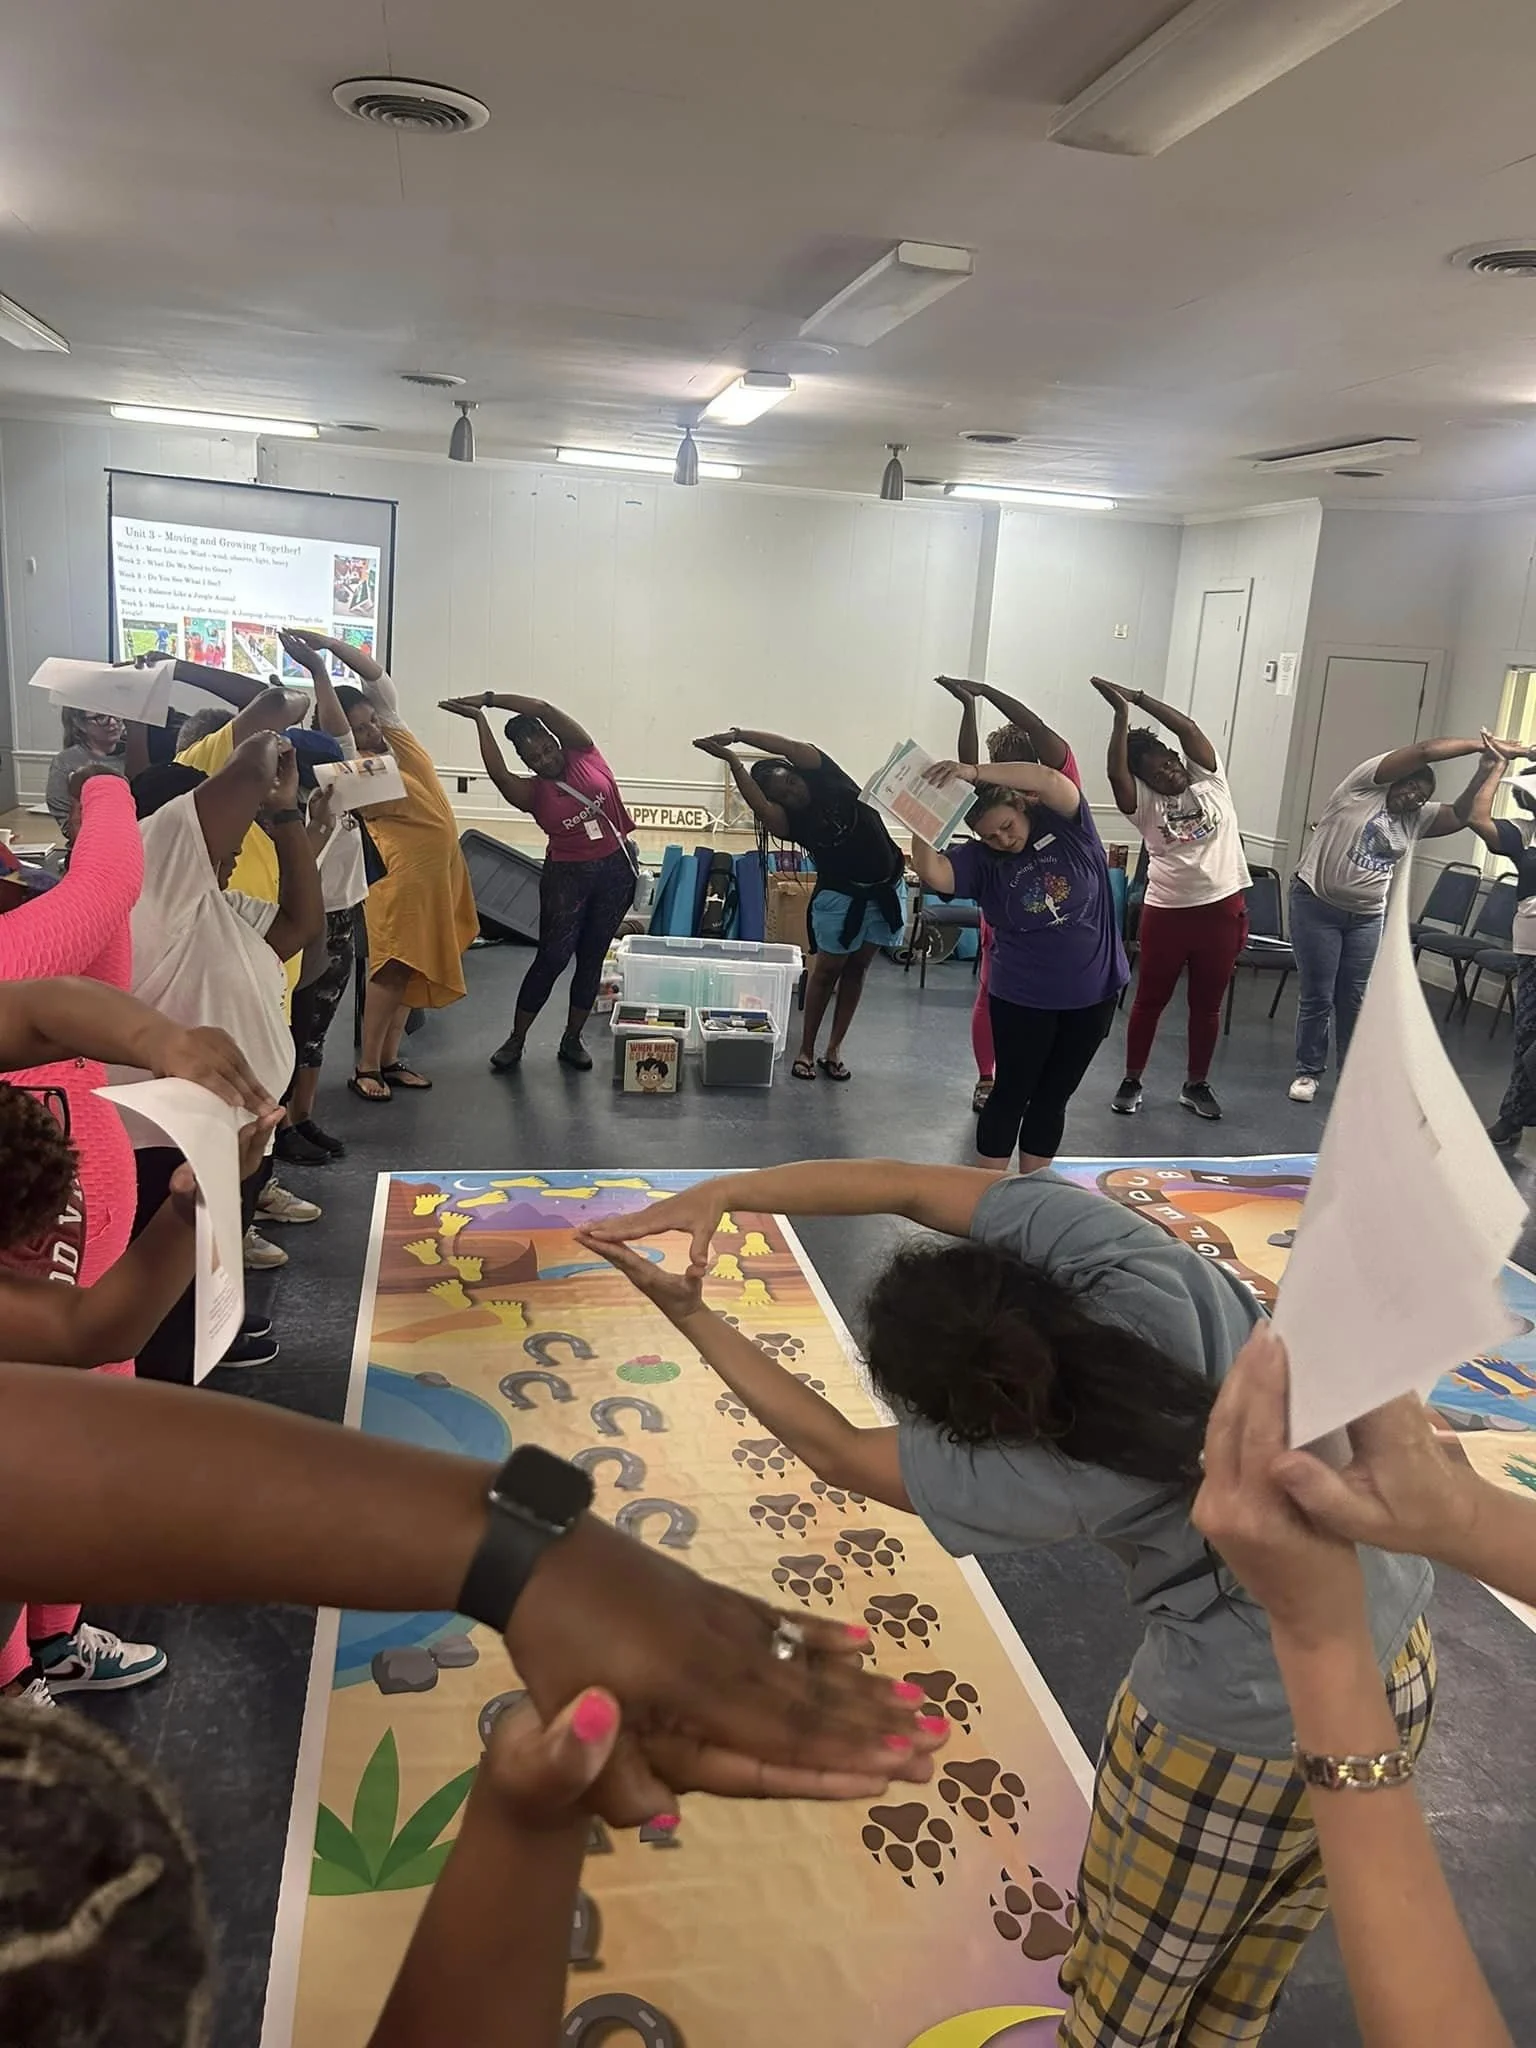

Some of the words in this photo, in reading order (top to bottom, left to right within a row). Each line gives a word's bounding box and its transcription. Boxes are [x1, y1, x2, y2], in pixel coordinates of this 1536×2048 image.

[126, 527, 146, 538] Unit
[165, 531, 198, 546] Moving
[200, 535, 216, 546] and
[219, 537, 256, 551] Growing
[259, 542, 301, 555] Together!
[661, 809, 702, 826] PLACE
[1128, 1176, 1149, 1186] C
[1156, 1171, 1186, 1179] B
[1201, 1175, 1230, 1184] A
[1128, 1190, 1152, 1201] D
[1155, 1206, 1185, 1220] E
[1189, 1226, 1210, 1239] F
[1197, 1243, 1220, 1257] G
